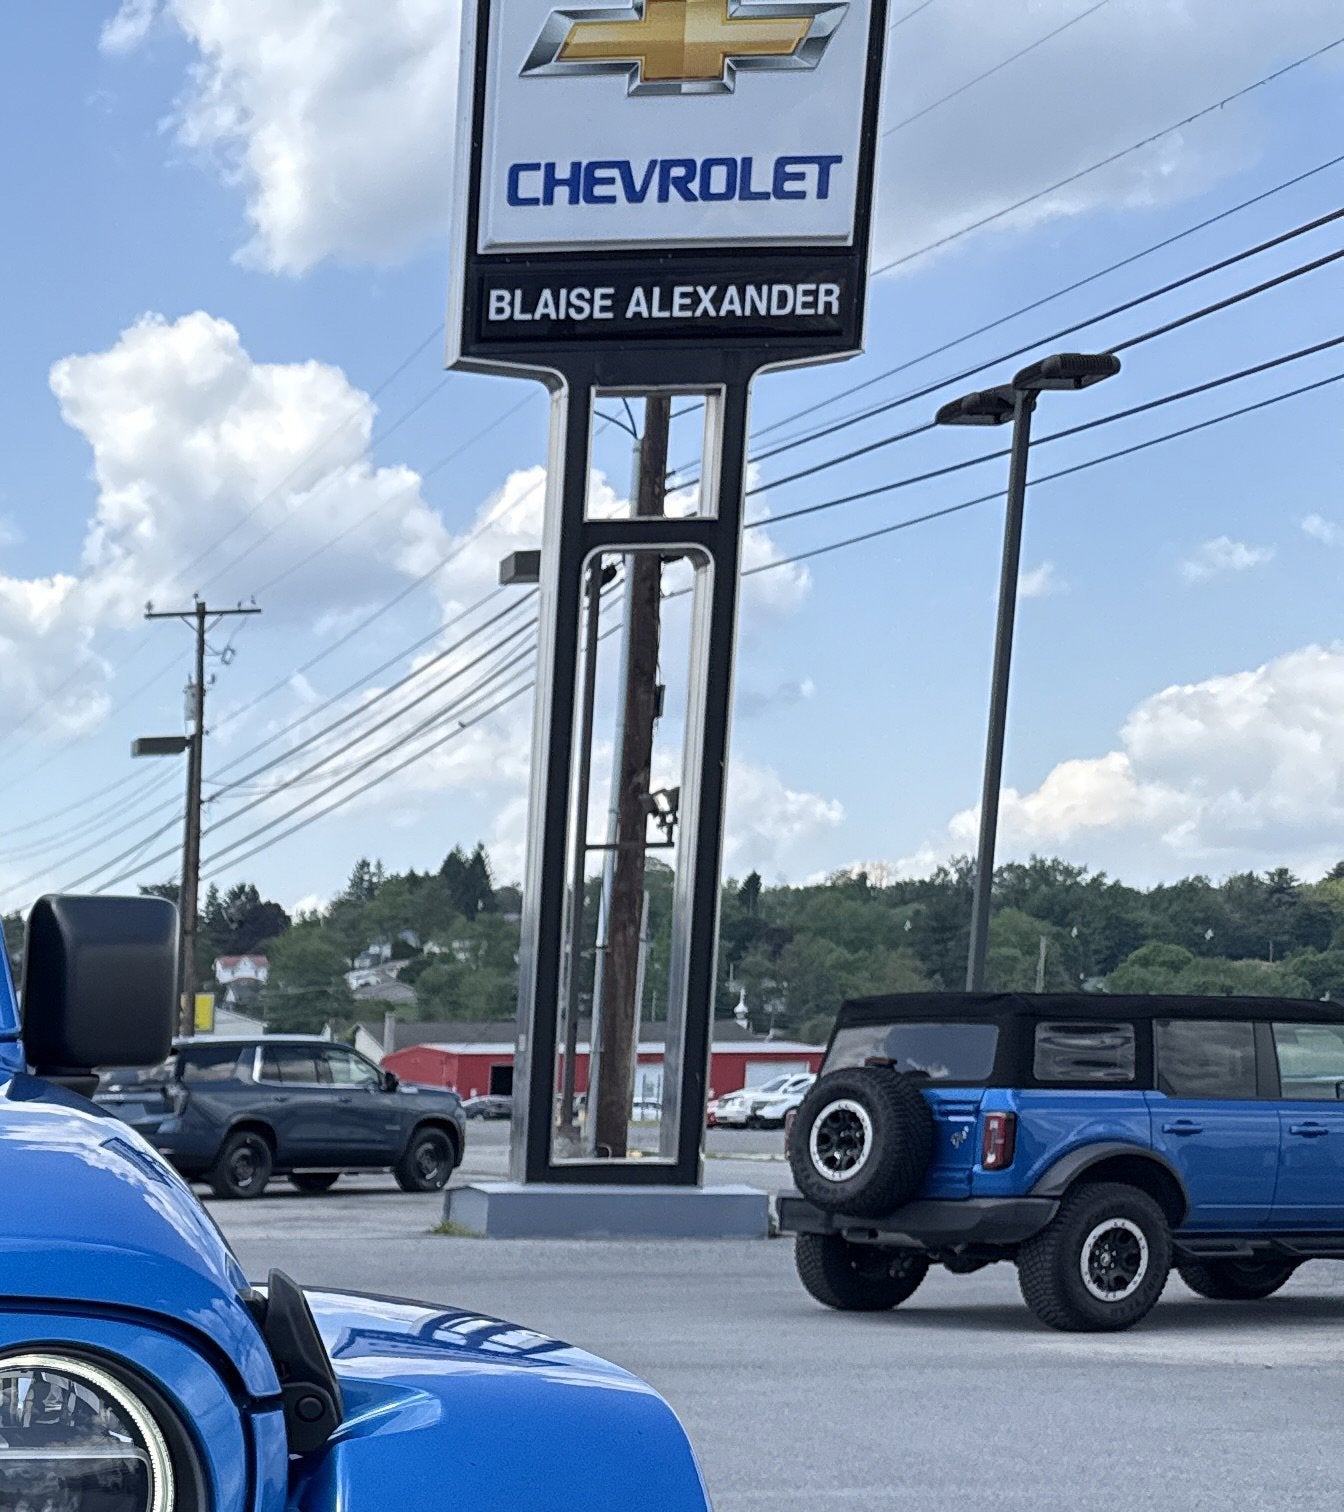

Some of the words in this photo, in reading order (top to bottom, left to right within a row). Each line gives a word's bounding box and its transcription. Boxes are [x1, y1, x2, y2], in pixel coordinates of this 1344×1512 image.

[507, 155, 842, 206] CHEVROLET
[487, 286, 615, 322] BLAISE
[625, 283, 841, 320] ALEXANDER
